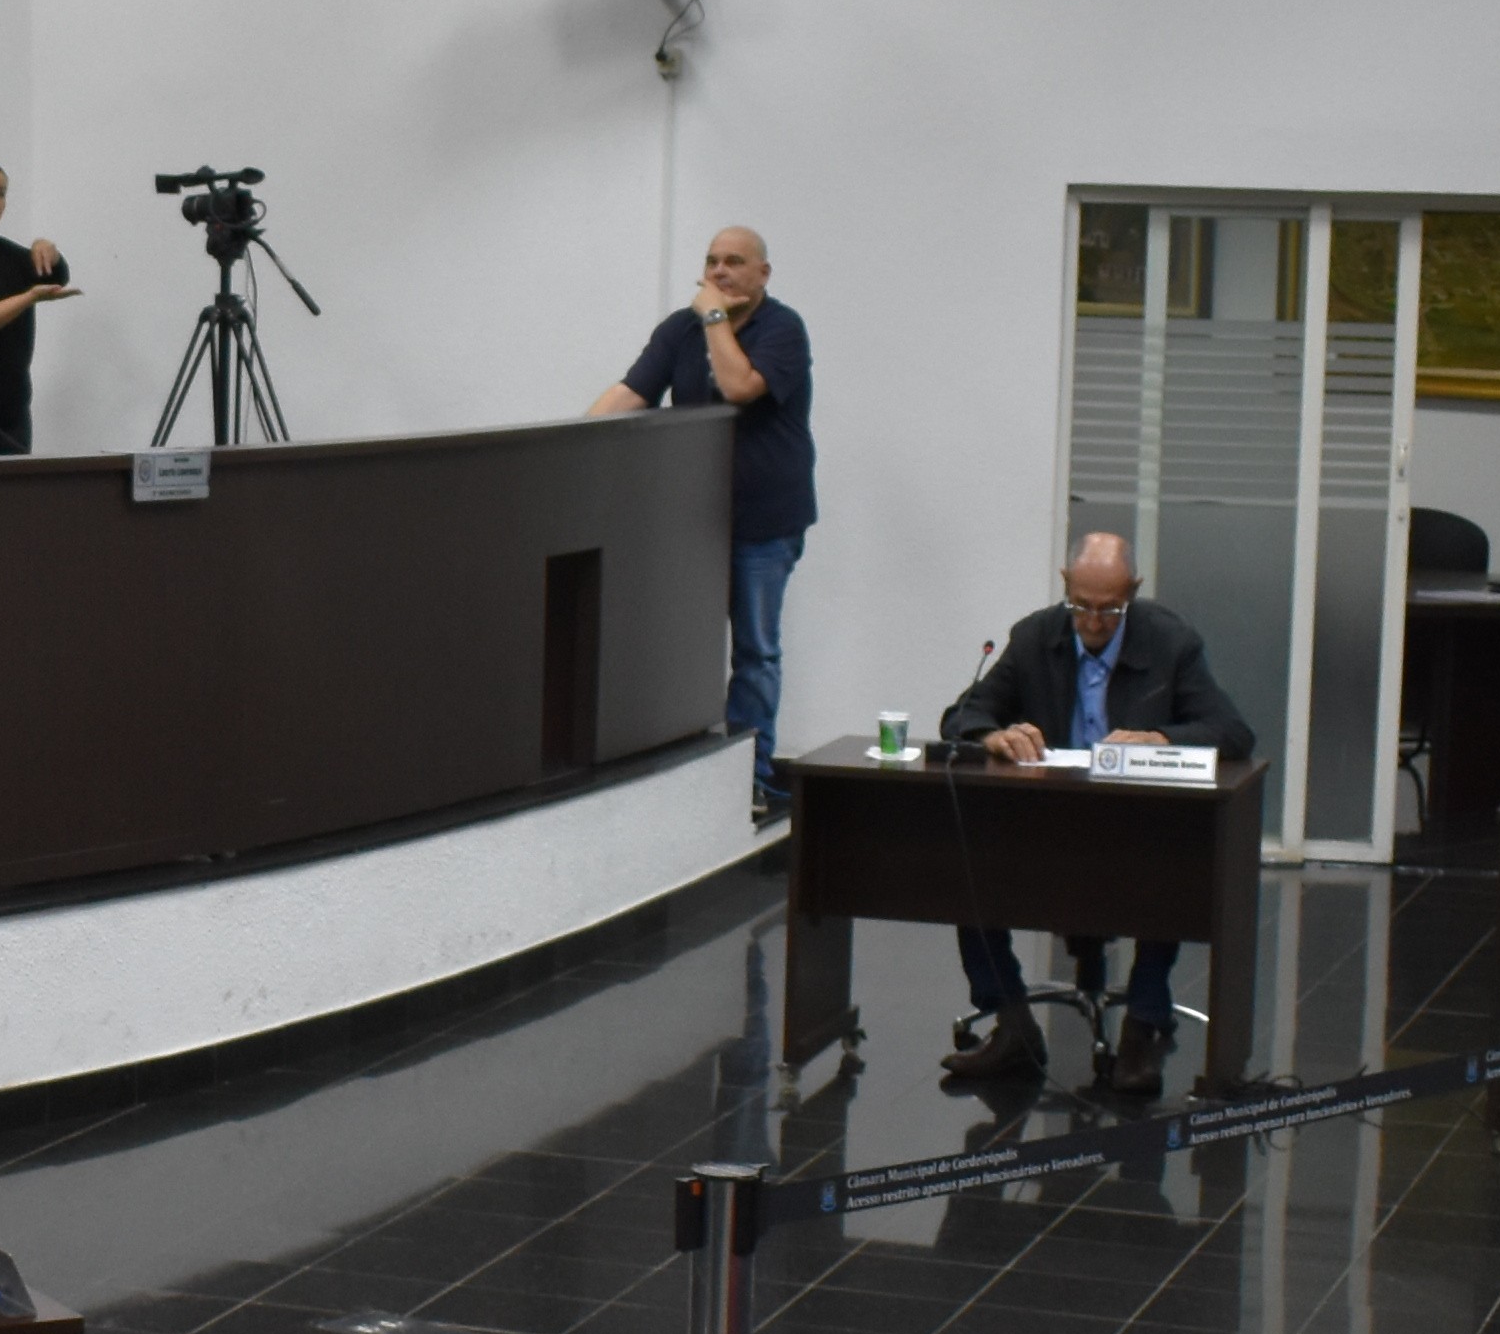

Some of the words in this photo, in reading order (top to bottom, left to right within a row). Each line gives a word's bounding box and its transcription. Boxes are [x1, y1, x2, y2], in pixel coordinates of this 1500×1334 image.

[1188, 1131, 1220, 1145] Acesso
[1219, 1122, 1254, 1139] restrito
[1285, 1111, 1306, 1127] para
[1190, 1110, 1224, 1126] Câmara
[1224, 1099, 1268, 1118] Municipal
[845, 1193, 882, 1210] Acesso
[881, 1184, 921, 1202] restrito
[921, 1179, 957, 1198] apenas
[956, 1174, 982, 1192] para
[981, 1162, 1042, 1185] funcionários
[1042, 1162, 1051, 1174] e
[846, 1173, 886, 1190] Câmara
[886, 1161, 937, 1184] Municipal
[937, 1157, 950, 1174] de
[951, 1147, 1018, 1172] Cordeirópolis
